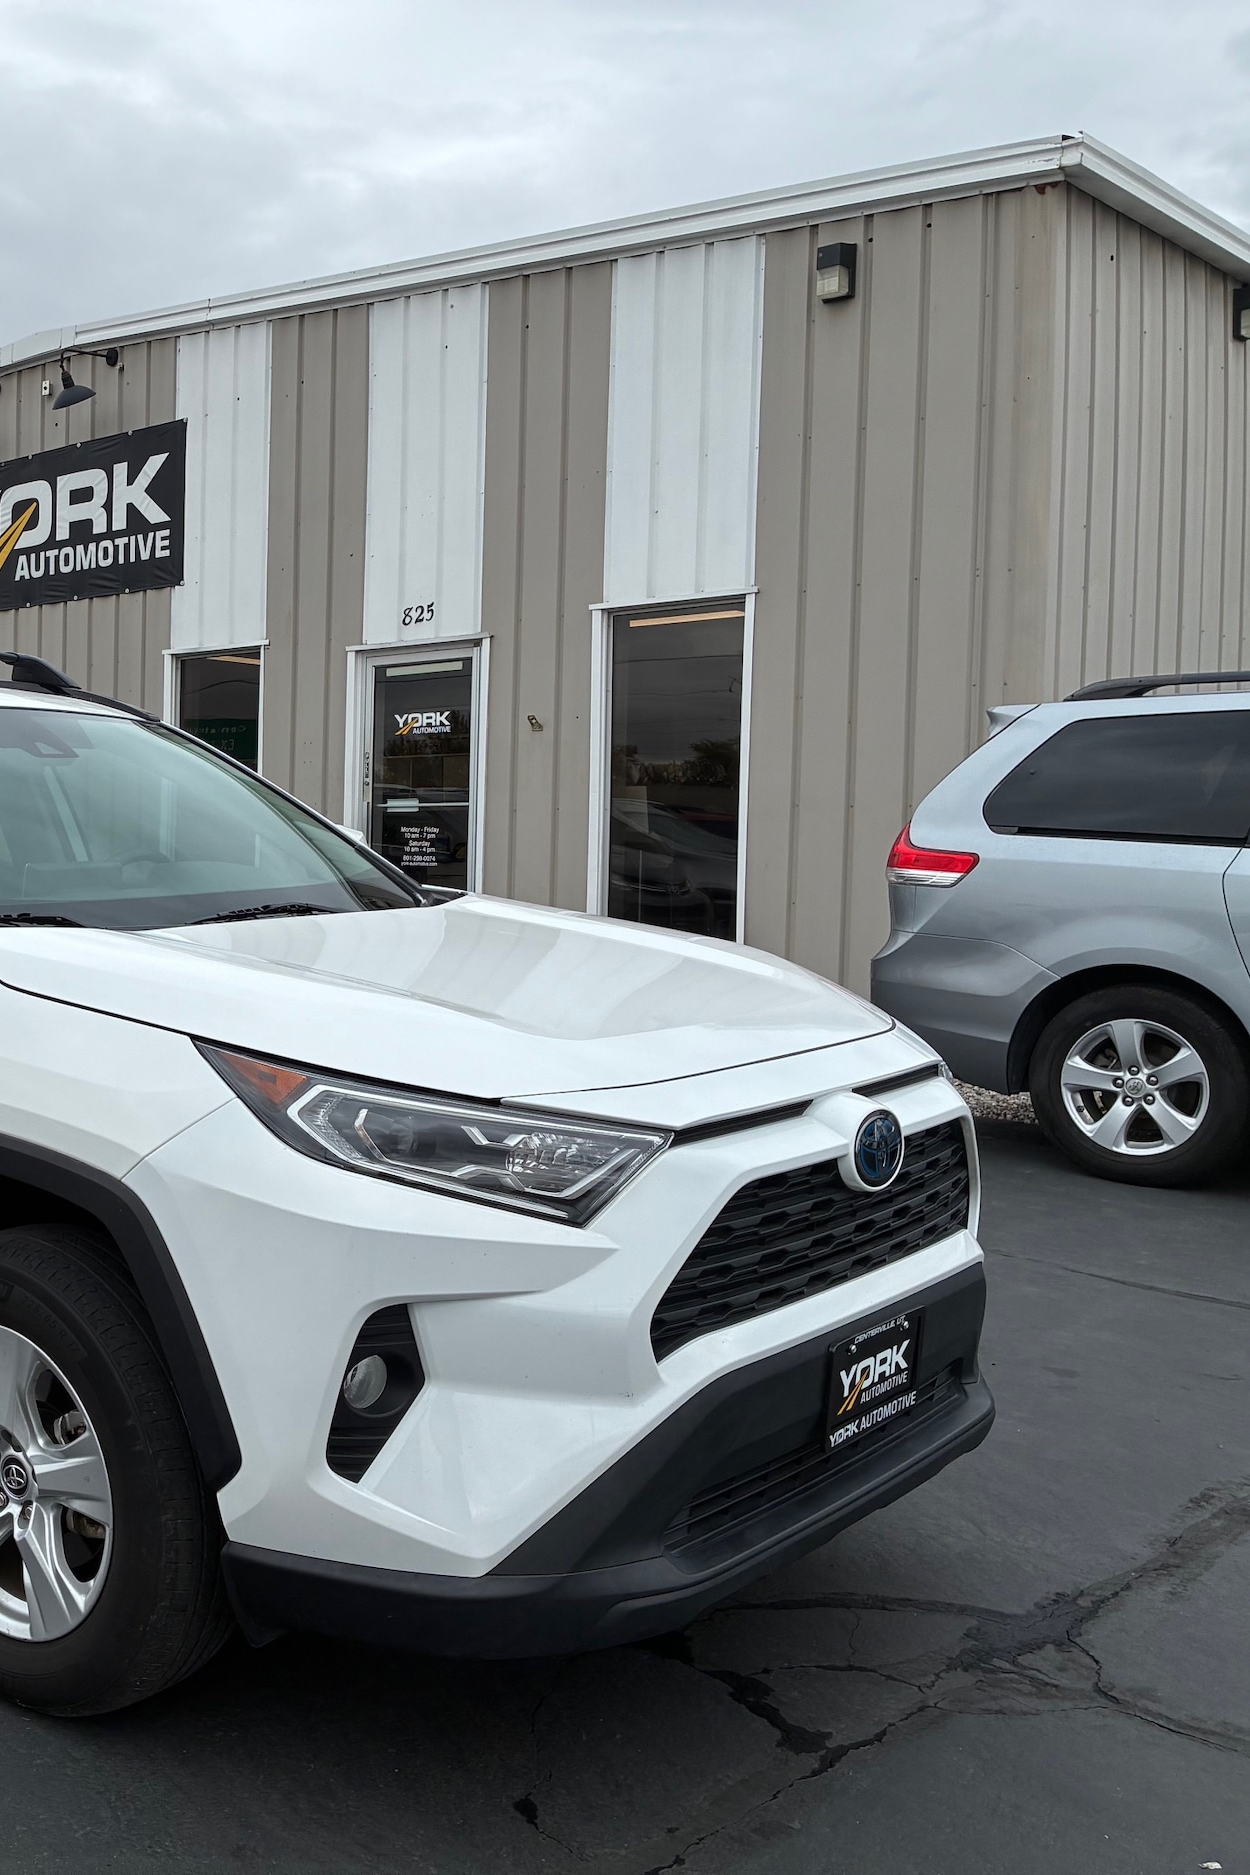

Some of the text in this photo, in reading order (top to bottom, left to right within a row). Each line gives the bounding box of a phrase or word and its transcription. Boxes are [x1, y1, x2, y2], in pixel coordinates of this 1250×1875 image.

[14, 528, 171, 582] AUTOMOTIVE
[401, 601, 435, 627] 825
[394, 711, 451, 728] YORK
[412, 725, 452, 735] AUTOMOTIVE
[839, 1339, 911, 1398] YORK
[860, 1370, 908, 1404] AUTOMOTIVE
[829, 1390, 917, 1448] YORK AUTOMOTIVE
